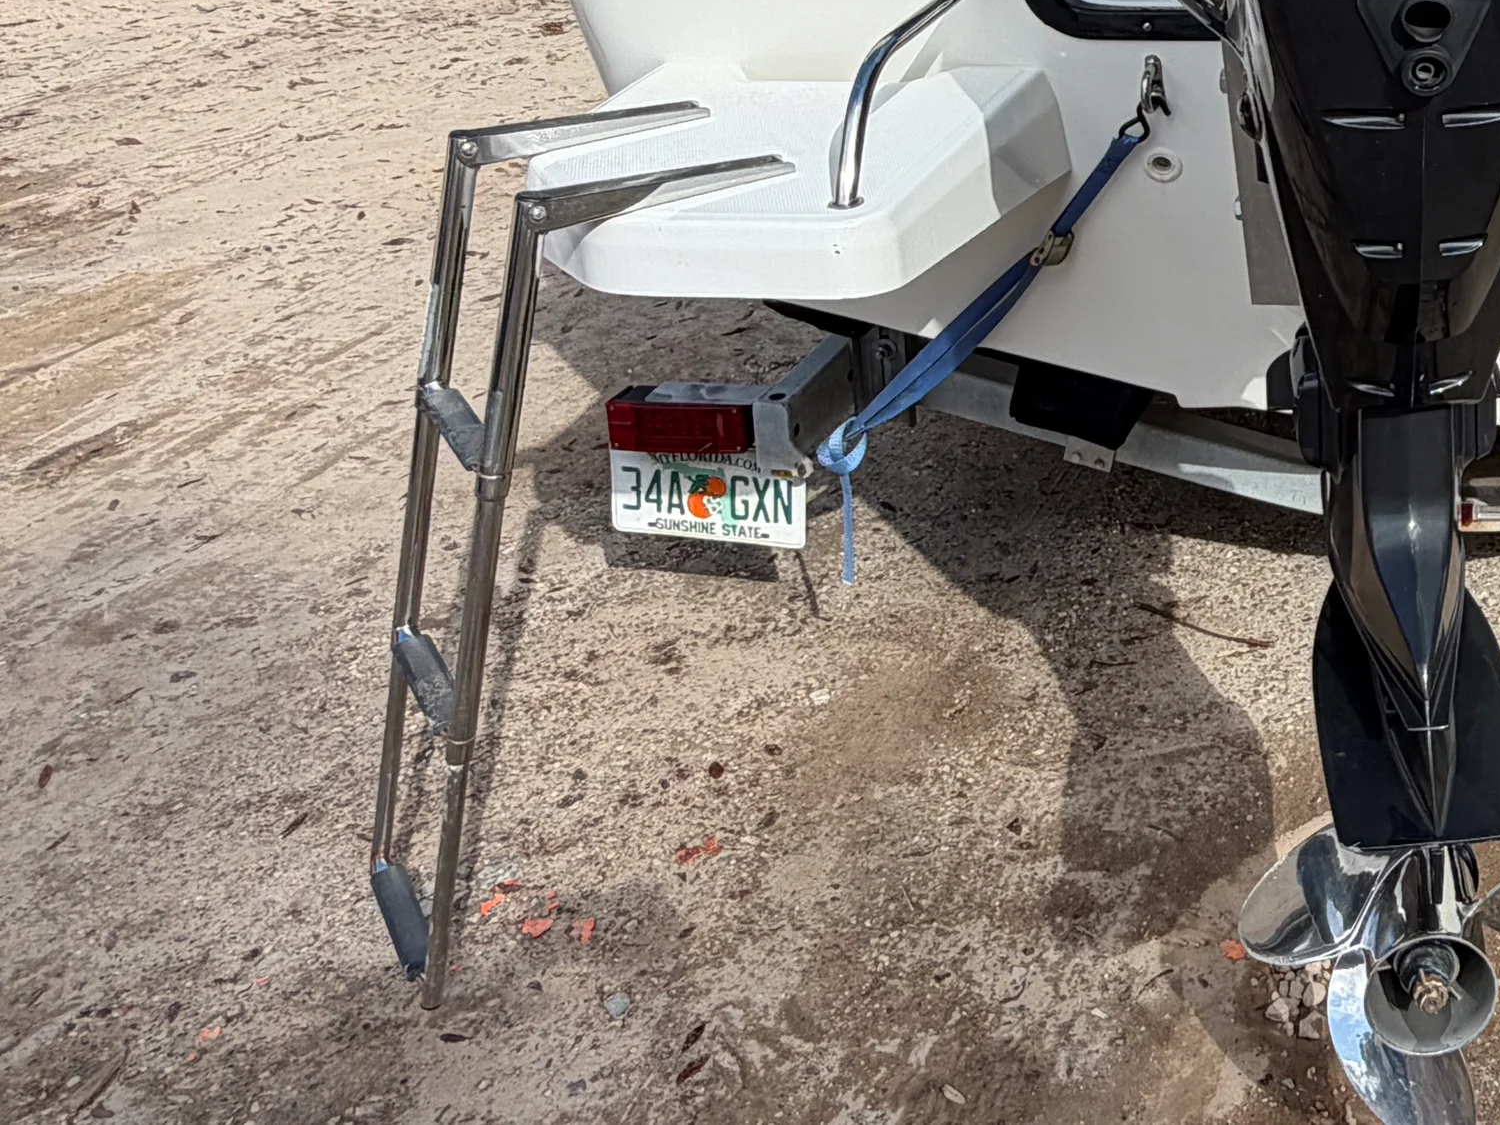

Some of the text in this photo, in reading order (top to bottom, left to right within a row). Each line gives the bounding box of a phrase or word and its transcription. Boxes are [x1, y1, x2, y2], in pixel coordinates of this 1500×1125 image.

[621, 466, 793, 525] 34A GXN
[655, 517, 763, 539] SUNSHINE STATE
